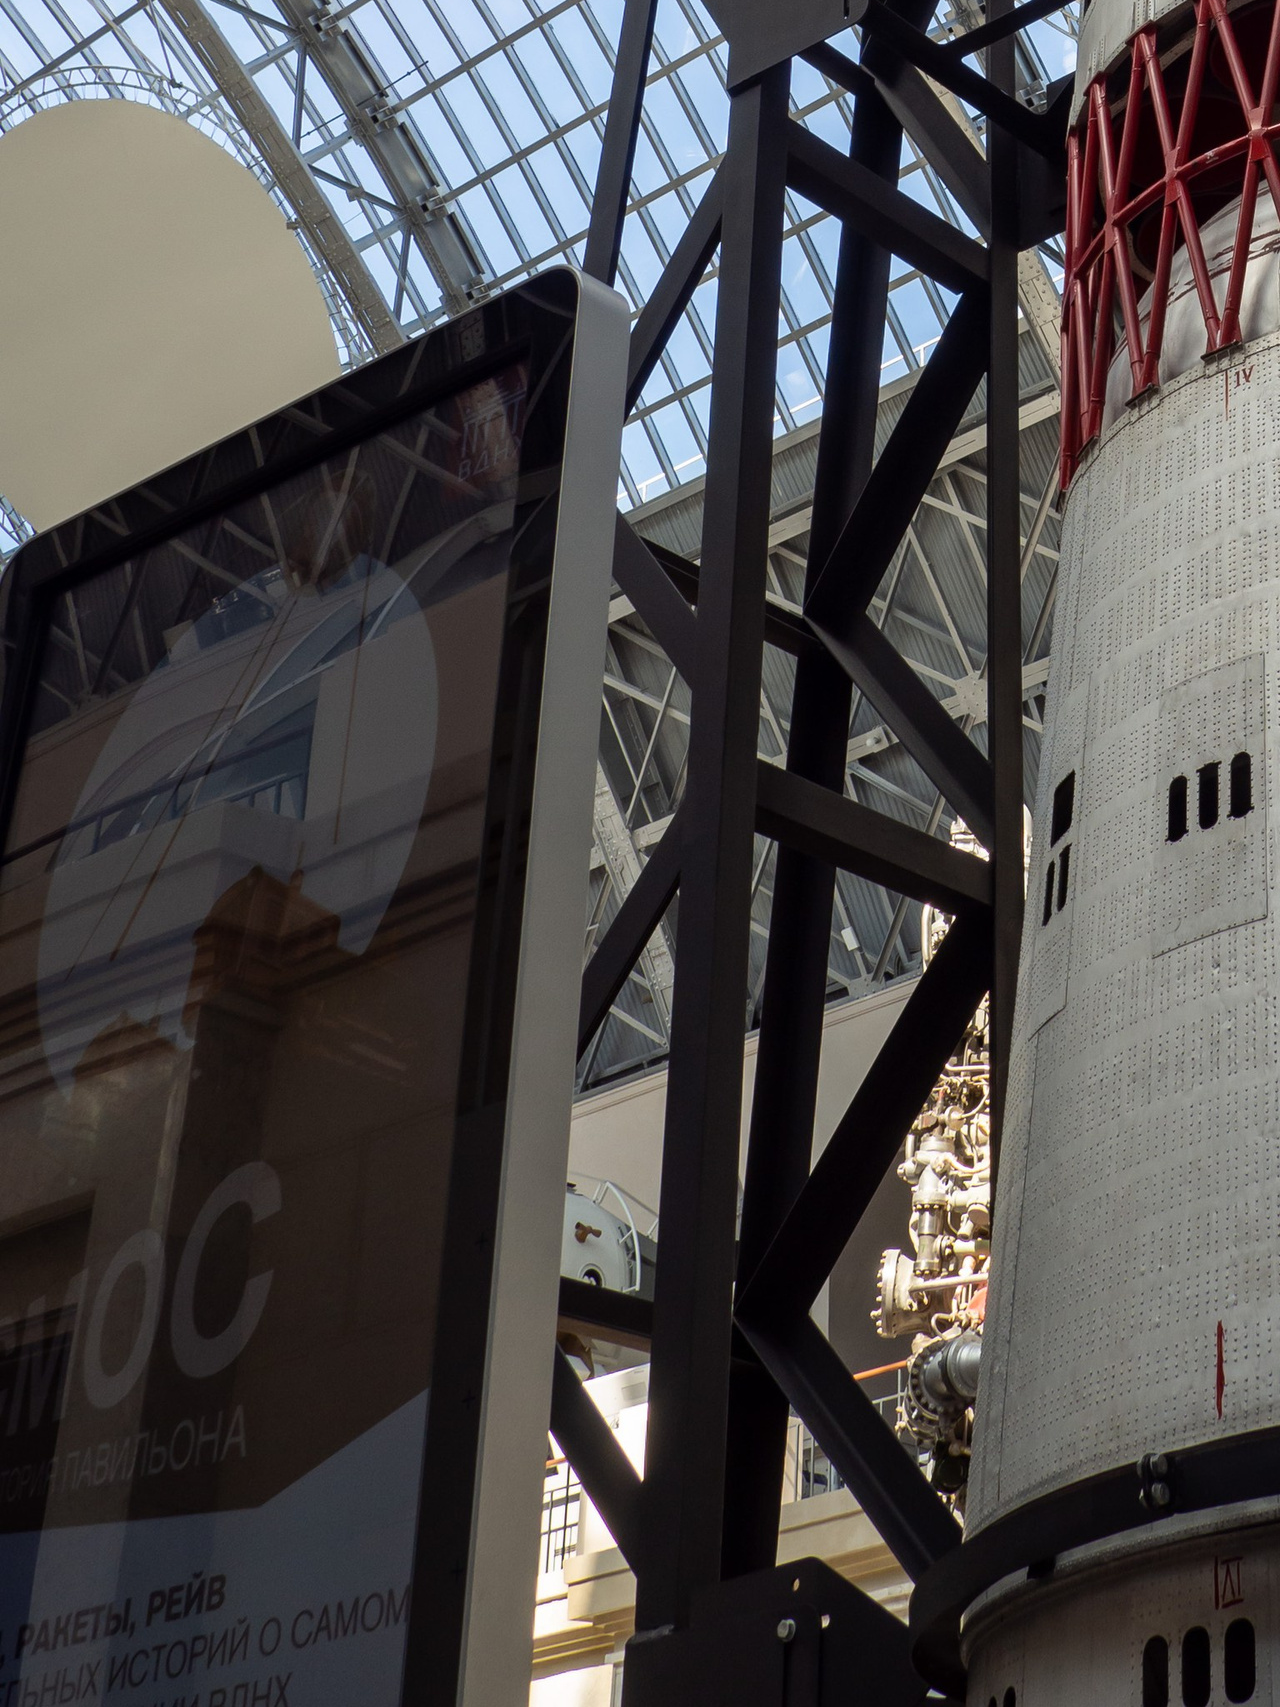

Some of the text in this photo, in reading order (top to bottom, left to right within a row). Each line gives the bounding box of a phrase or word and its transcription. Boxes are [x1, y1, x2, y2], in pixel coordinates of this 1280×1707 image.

[1235, 364, 1256, 389] IV
[62, 1404, 248, 1493] ПАВИЛЬОНА
[15, 1570, 227, 1661] РАКЕТЫ, РЕЙВ
[107, 1616, 250, 1693] ИСТОРИЙ
[259, 1617, 282, 1657] О
[290, 1584, 412, 1650] САМОМ
